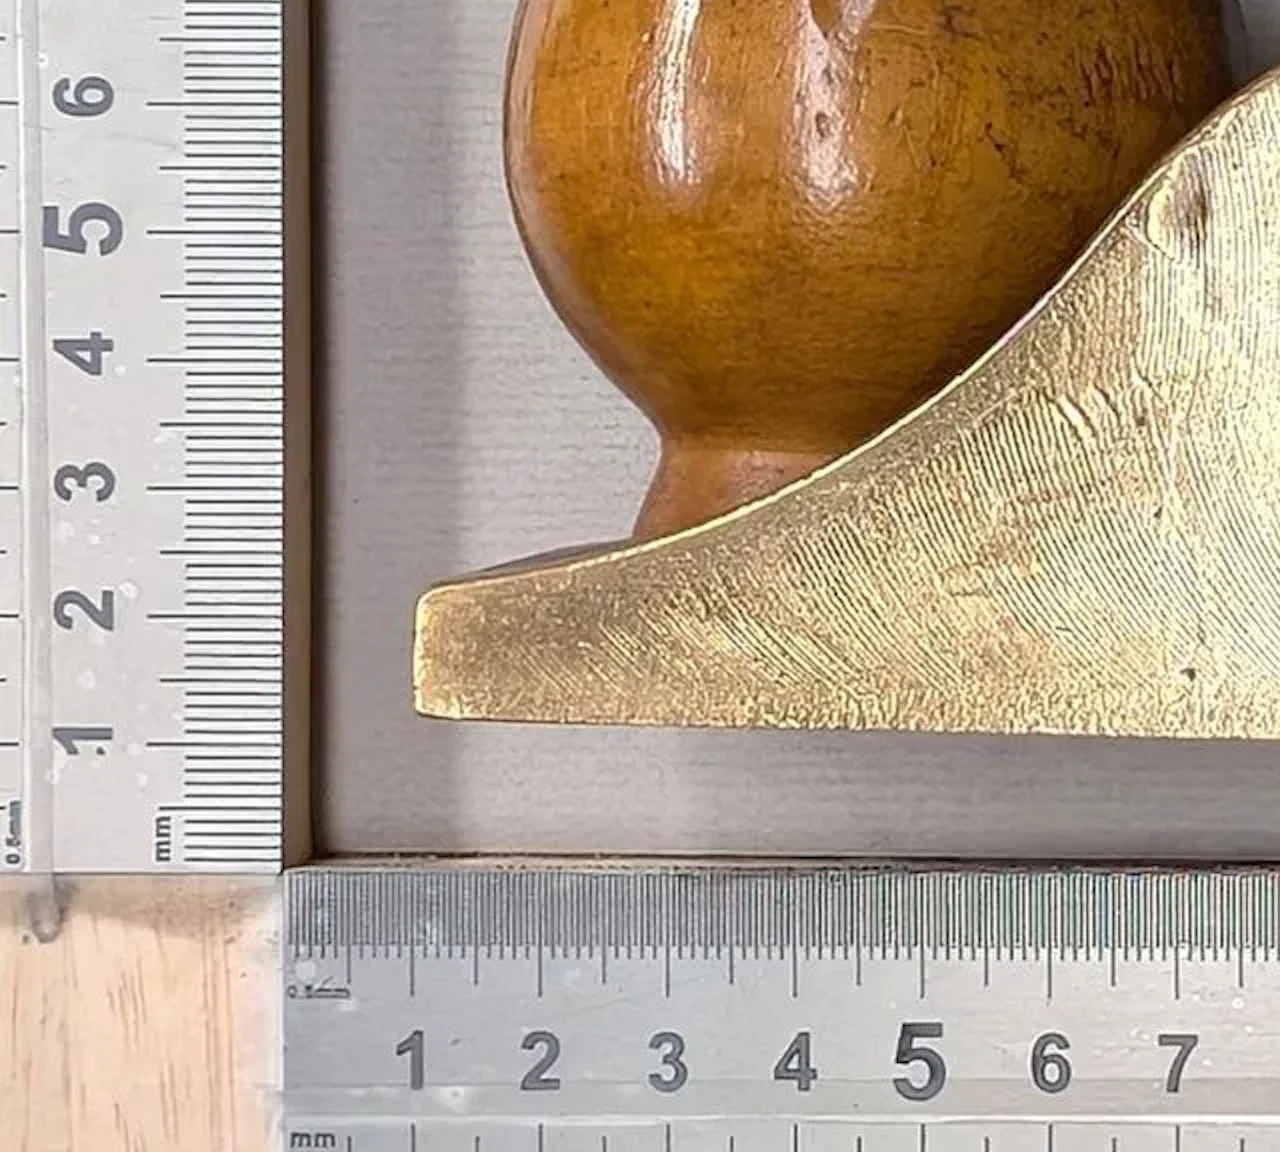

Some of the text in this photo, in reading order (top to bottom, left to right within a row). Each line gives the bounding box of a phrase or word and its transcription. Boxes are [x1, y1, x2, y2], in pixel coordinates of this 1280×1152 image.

[53, 77, 113, 116] 6
[42, 203, 122, 256] 5
[53, 332, 113, 375] 4
[54, 463, 115, 502] 3
[54, 591, 113, 631] 2
[52, 728, 112, 755] 1
[155, 815, 171, 862] mm
[396, 1030, 423, 1089] 1
[521, 1031, 560, 1090] 2
[649, 1032, 687, 1092] 3
[774, 1032, 817, 1091] 4
[893, 1023, 945, 1101] 5
[1032, 1033, 1071, 1093] 6
[1159, 1034, 1198, 1093] 7
[290, 1131, 336, 1149] mm
